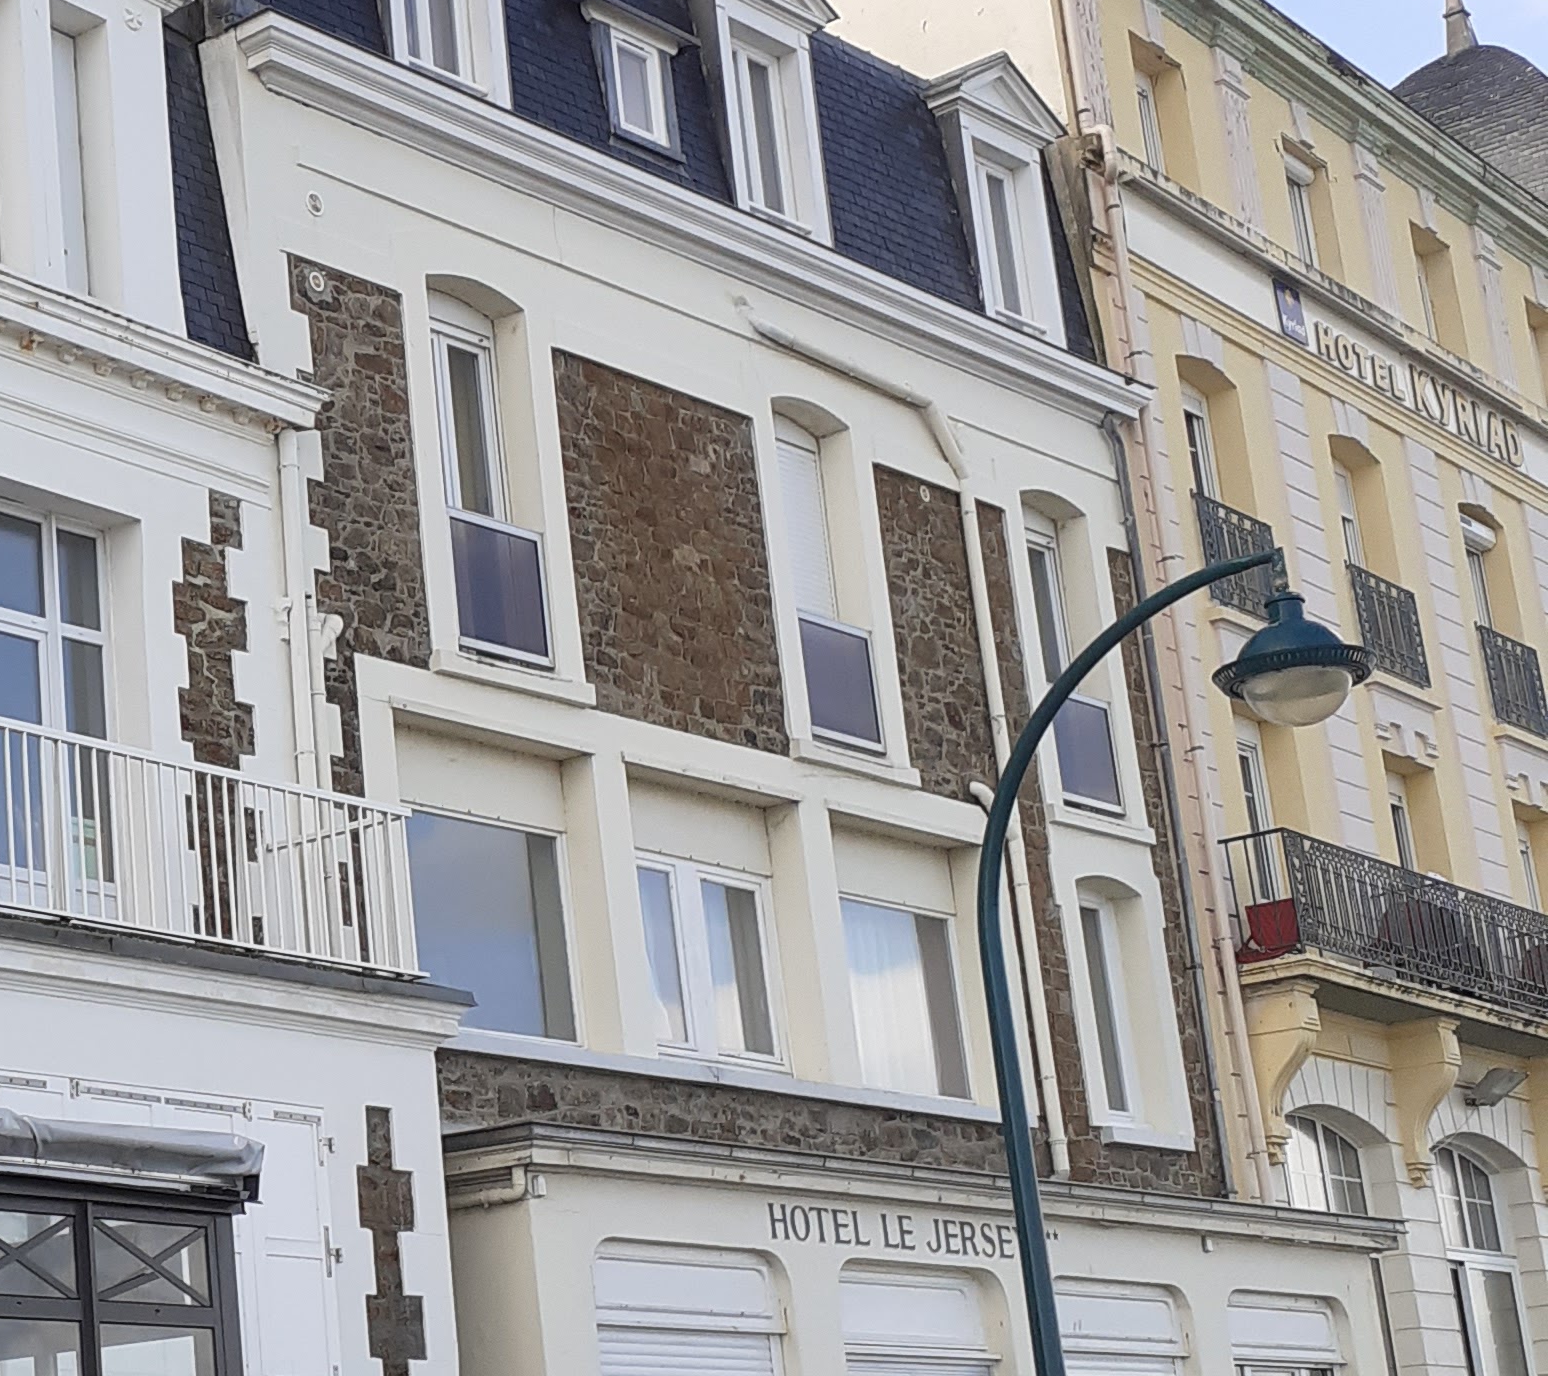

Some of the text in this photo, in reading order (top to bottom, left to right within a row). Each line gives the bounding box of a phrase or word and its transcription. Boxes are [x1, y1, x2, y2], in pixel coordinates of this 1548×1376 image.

[1314, 321, 1524, 468] HOTEL KYRIAD
[767, 1202, 1018, 1259] HOTEL LE JERSE
